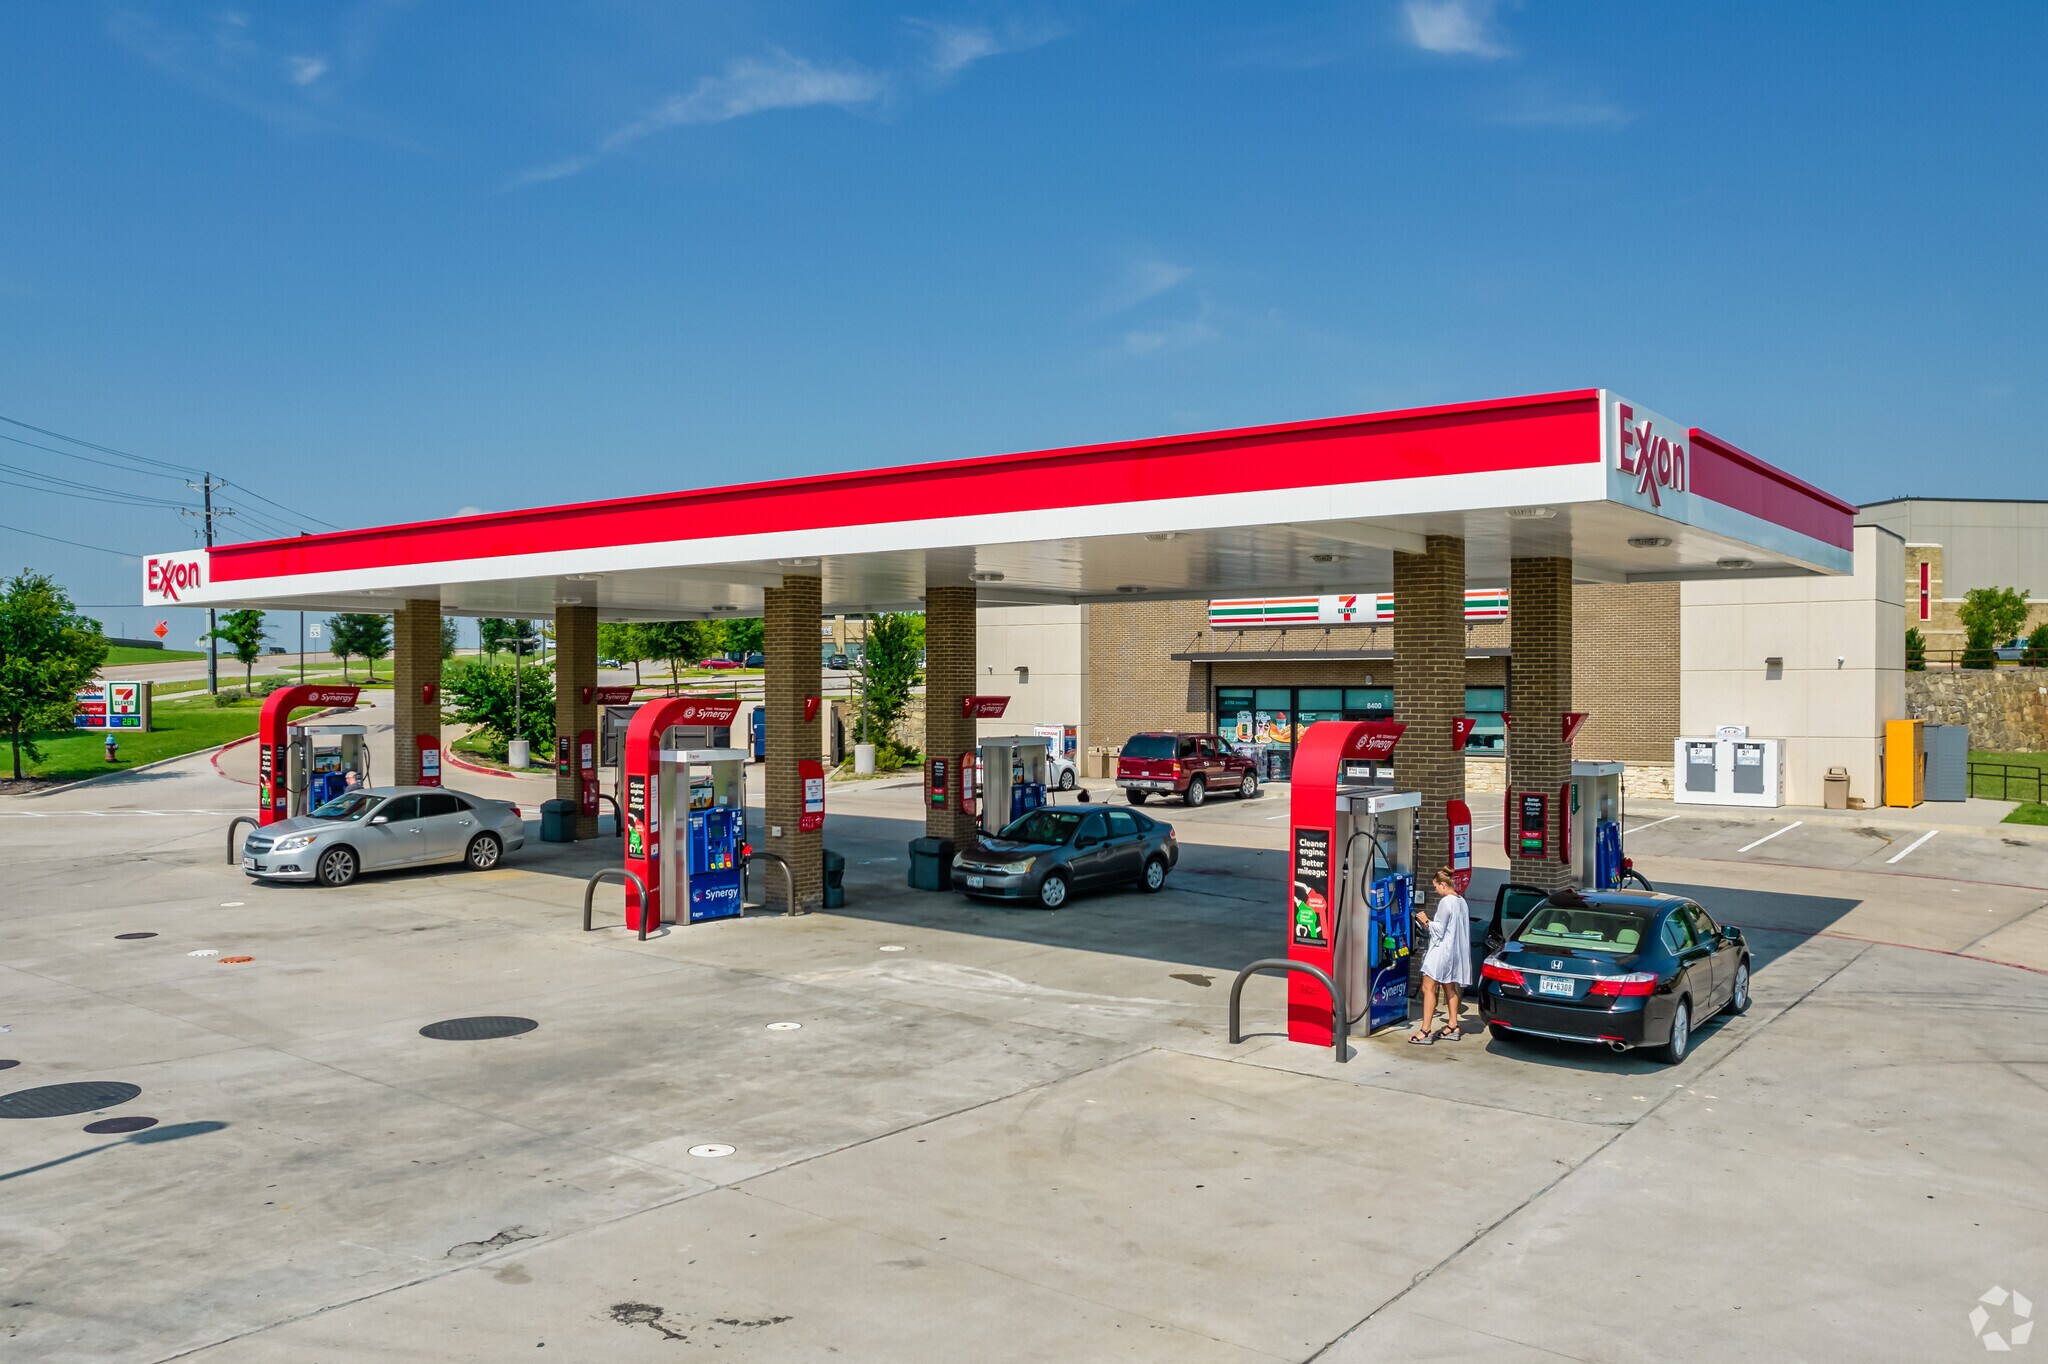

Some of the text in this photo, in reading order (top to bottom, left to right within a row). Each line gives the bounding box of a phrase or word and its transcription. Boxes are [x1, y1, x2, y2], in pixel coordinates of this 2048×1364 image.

[1615, 402, 1685, 507] Exxon
[148, 559, 201, 601] Exxon
[1339, 595, 1357, 621] 7
[321, 693, 353, 703] Synergy
[605, 693, 630, 701] Synergy
[965, 698, 970, 706] 5
[807, 699, 812, 708] 7
[697, 708, 732, 720] Synergy
[980, 704, 1004, 714] Synergy
[1566, 716, 1572, 726] 1
[1456, 722, 1464, 732] 3
[1366, 736, 1395, 751] Synergy
[1299, 838, 1327, 848] Cleaner
[1299, 848, 1326, 857] engine.
[1301, 858, 1324, 868] Better
[705, 888, 738, 901] Synergy
[1381, 981, 1407, 1001] Synergy
